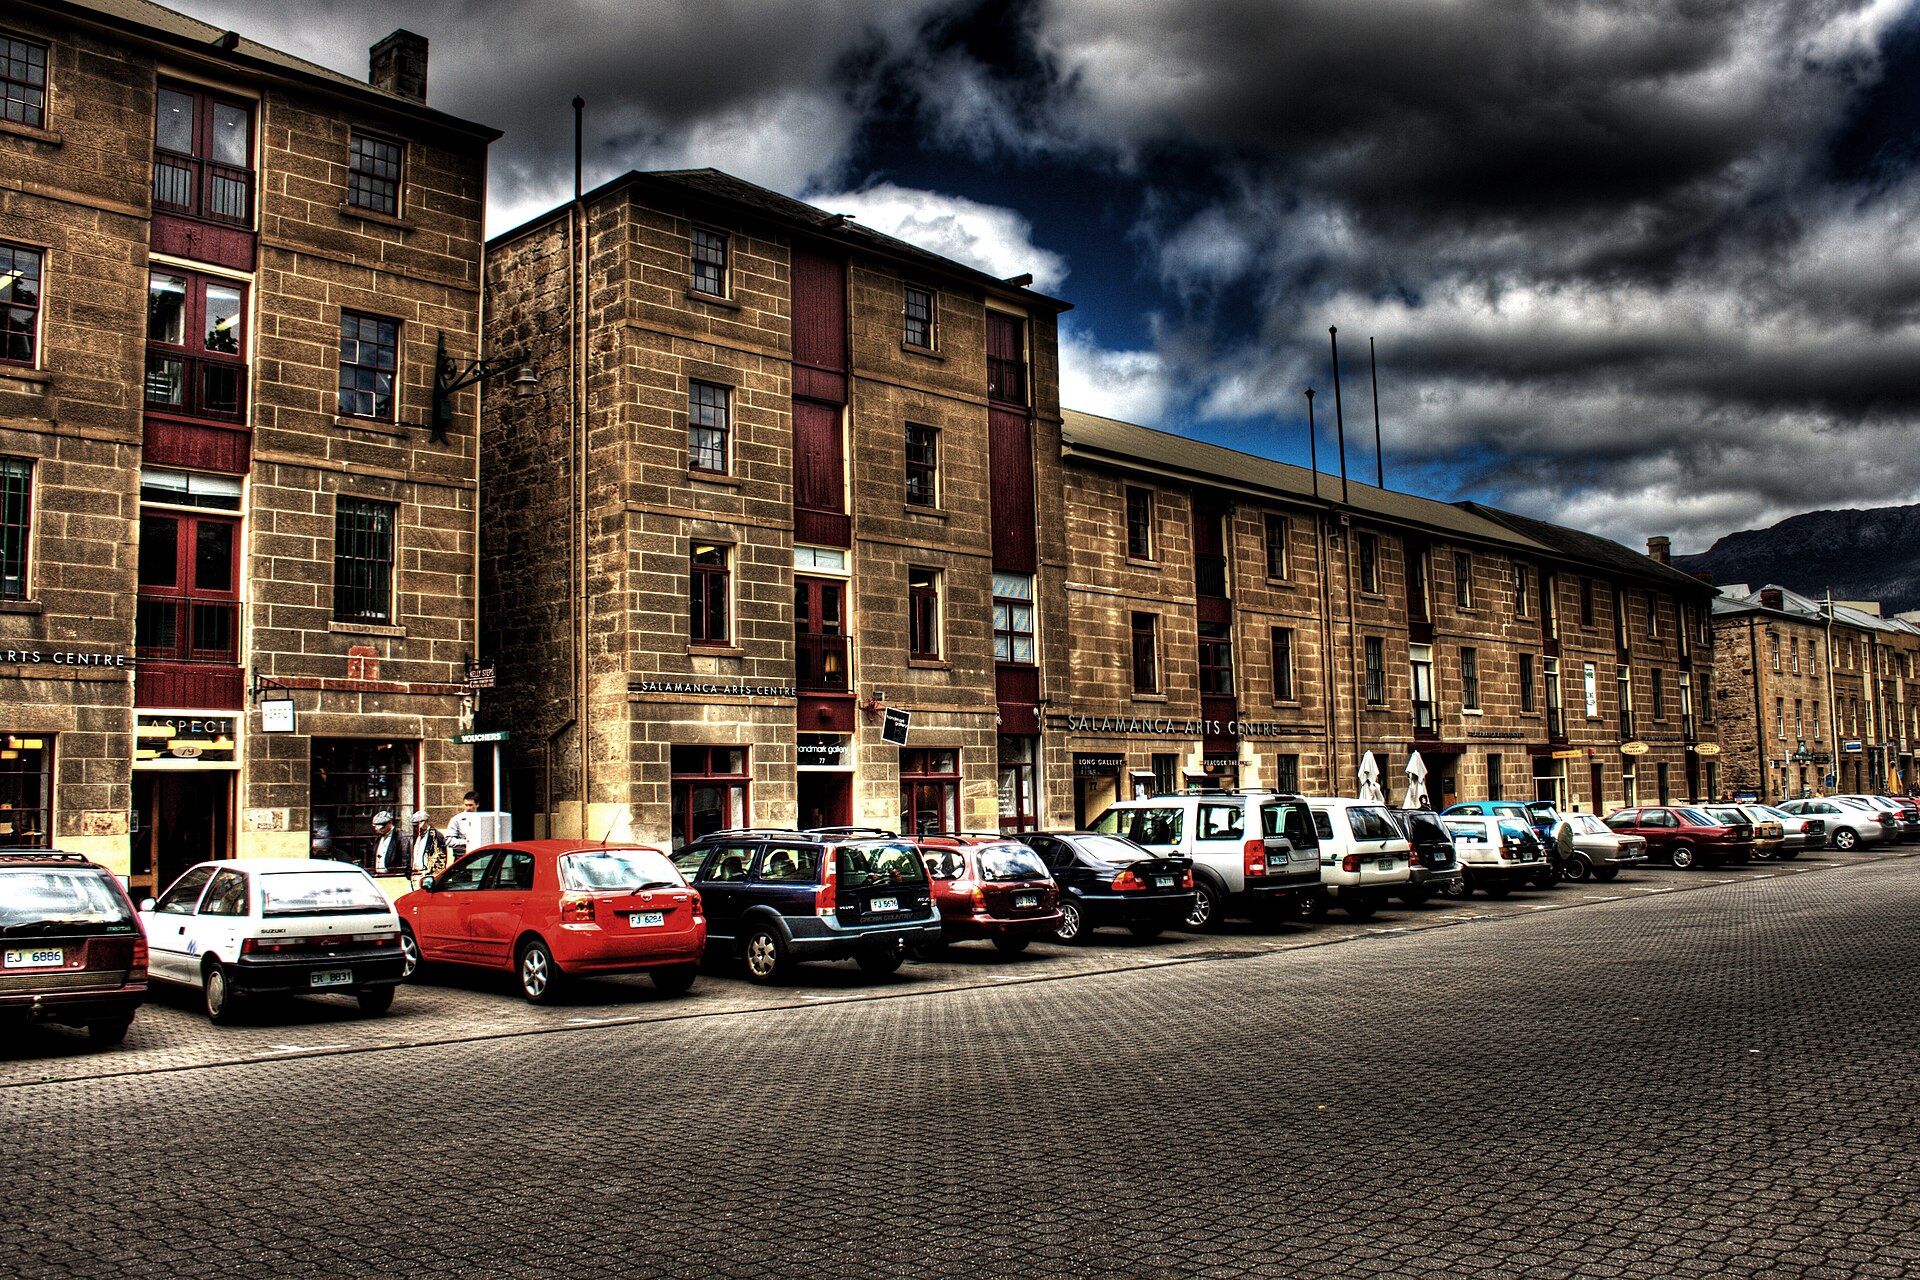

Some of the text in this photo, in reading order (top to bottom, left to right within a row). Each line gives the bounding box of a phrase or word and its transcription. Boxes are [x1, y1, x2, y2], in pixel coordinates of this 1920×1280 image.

[53, 652, 124, 666] CENTRE
[482, 669, 494, 677] STEPS
[642, 682, 796, 696] SALAMANCA ARTS CENTRE
[151, 719, 227, 733] ASPECT
[1068, 715, 1278, 736] SALAMANCA ARTS CENTRE
[461, 733, 502, 742] VOUCHERS
[181, 747, 194, 756] 79
[827, 746, 848, 754] gallery
[873, 901, 882, 909] FJ
[631, 916, 641, 924] FJ
[884, 913, 913, 921] COUNTRY
[7, 951, 61, 962] EJ 6886
[311, 972, 351, 983] ER 8831
